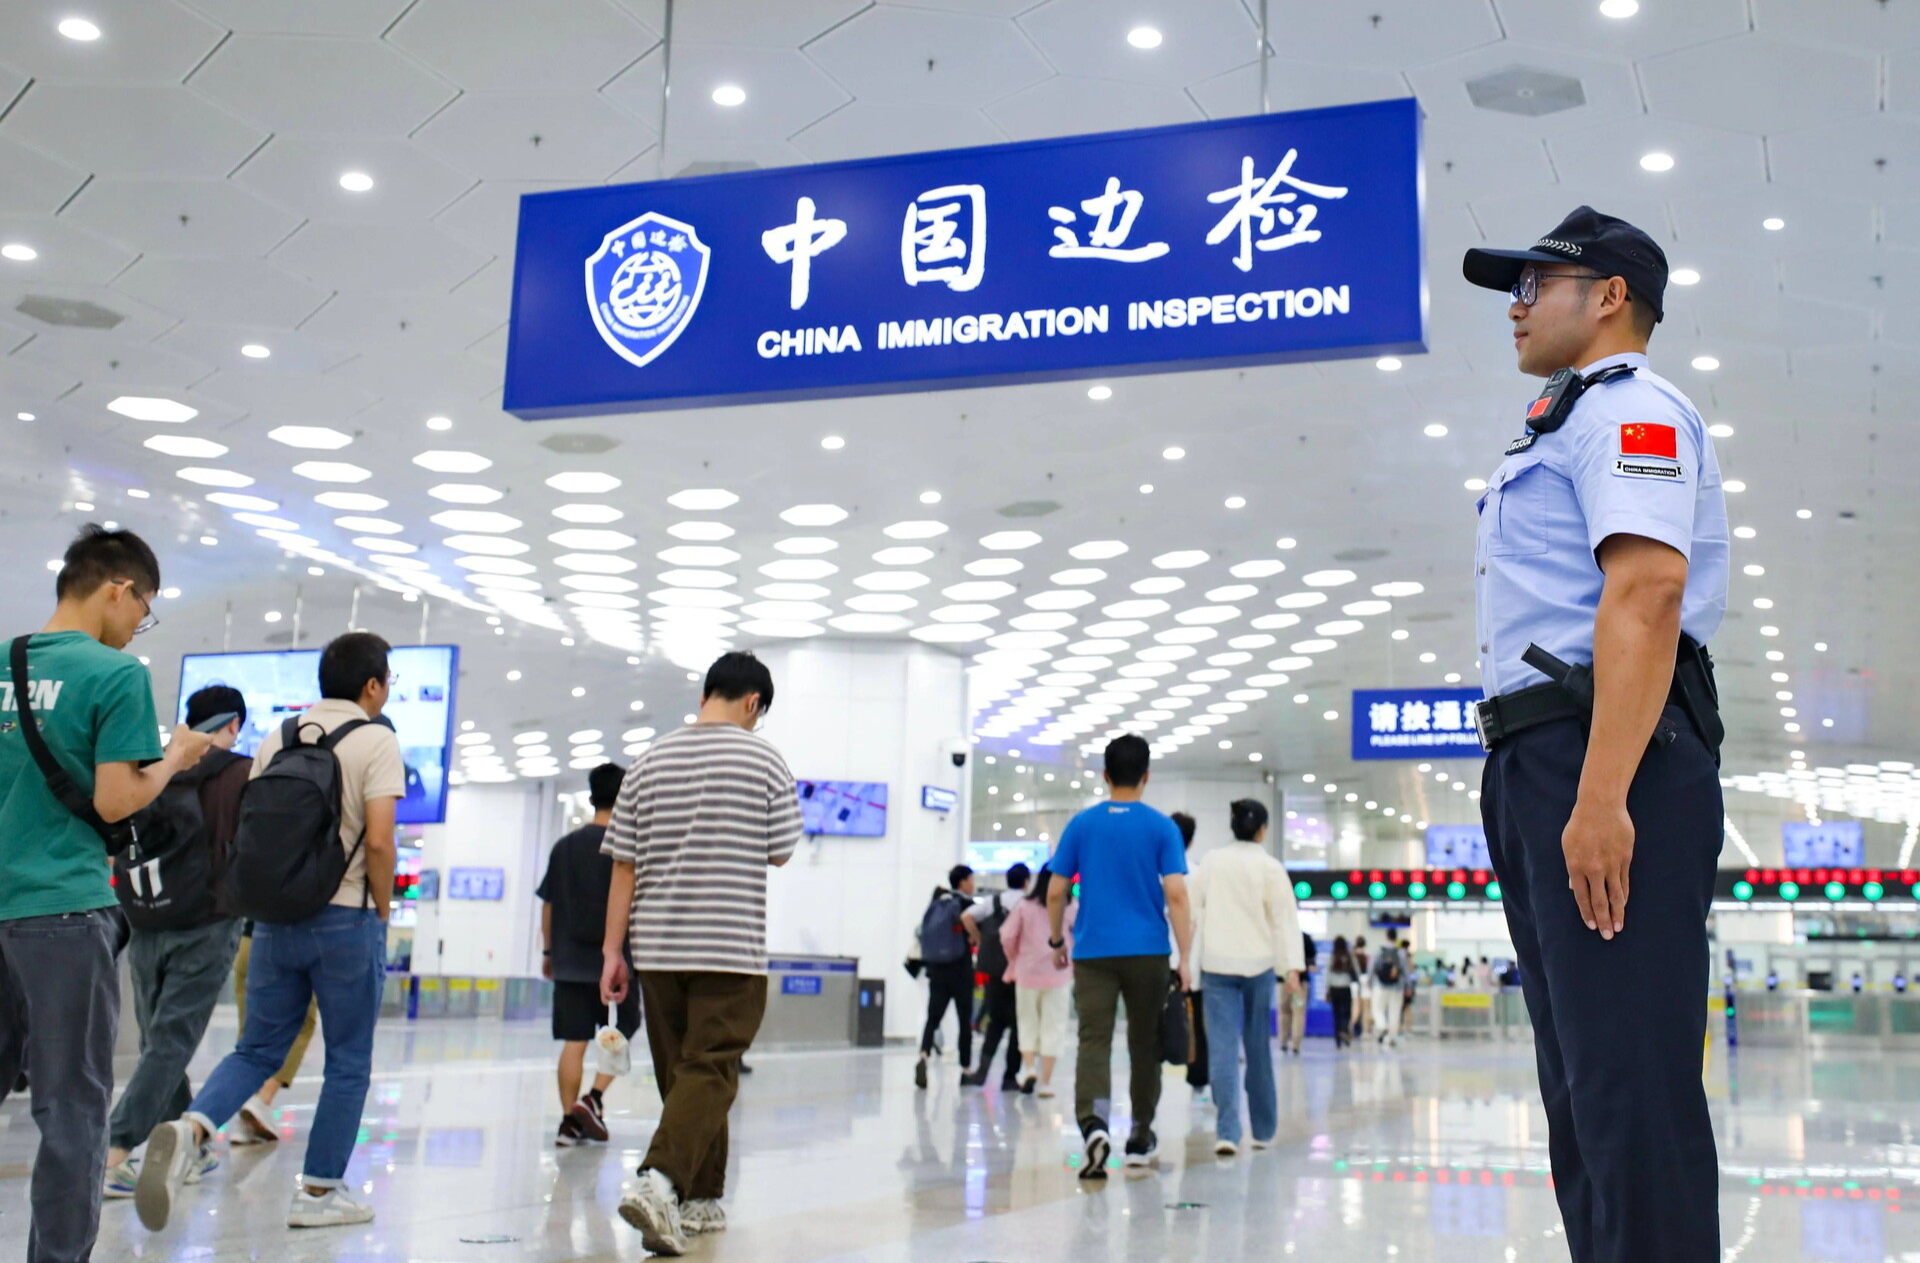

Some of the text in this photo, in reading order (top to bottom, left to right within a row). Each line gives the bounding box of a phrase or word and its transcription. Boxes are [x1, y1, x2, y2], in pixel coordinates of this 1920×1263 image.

[762, 149, 1349, 310] 中国边检
[757, 285, 1350, 358] CHINA IMMIGRATION INSPECTION
[1642, 468, 1676, 476] IMMIGRATION
